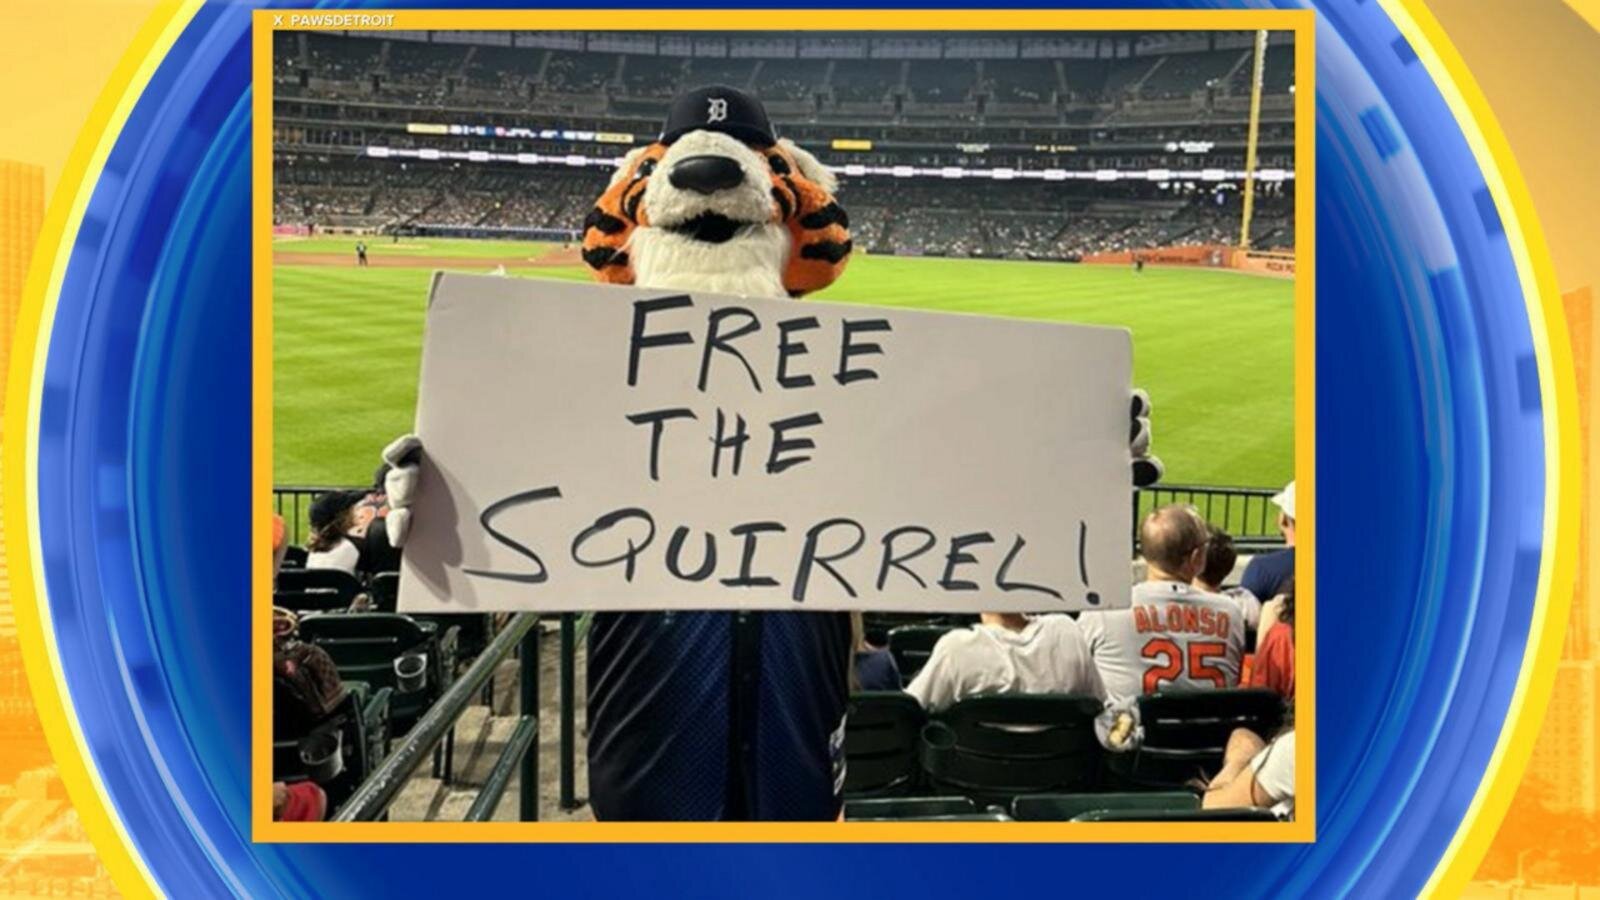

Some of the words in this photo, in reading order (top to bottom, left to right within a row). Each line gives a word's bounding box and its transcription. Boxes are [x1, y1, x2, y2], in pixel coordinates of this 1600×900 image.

[706, 97, 728, 124] D
[627, 294, 892, 393] FREE
[625, 407, 823, 481] THE
[462, 487, 1102, 605] SQUIRREL!
[1134, 603, 1229, 639] ALONSO
[1141, 638, 1226, 697] 25
